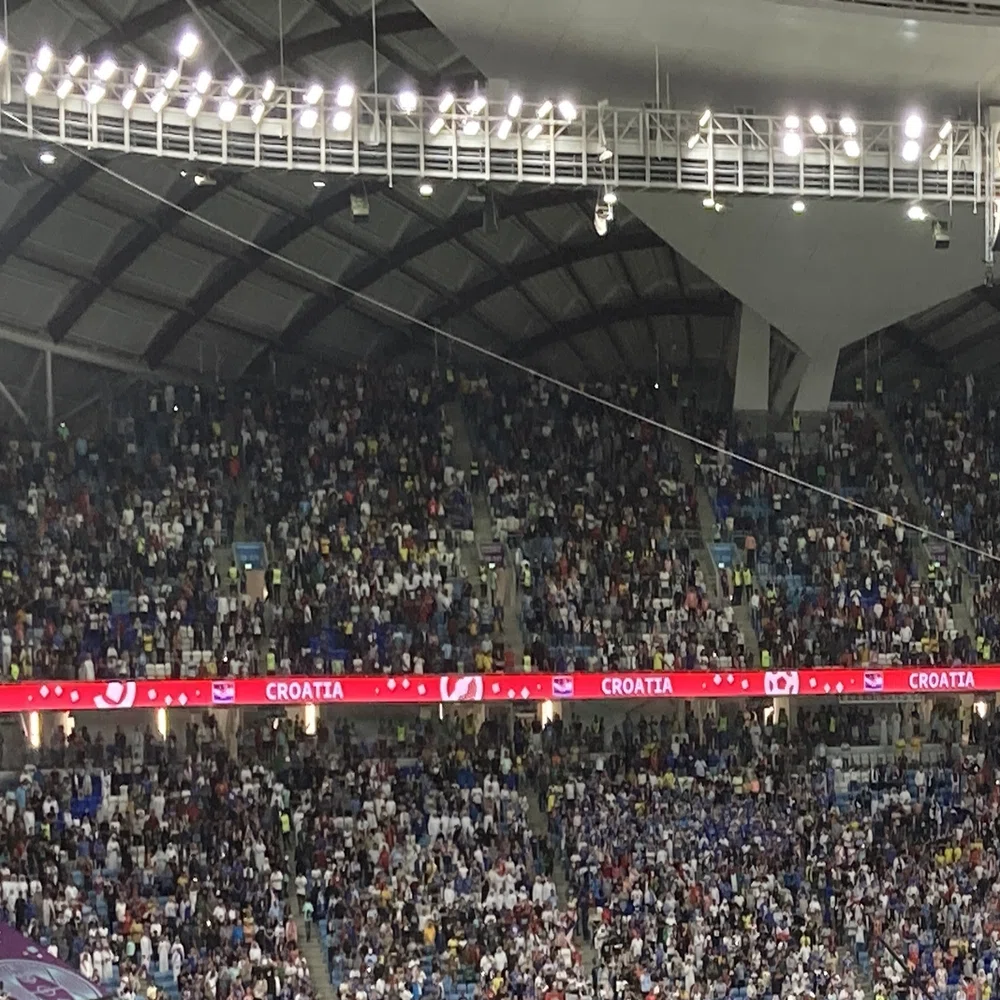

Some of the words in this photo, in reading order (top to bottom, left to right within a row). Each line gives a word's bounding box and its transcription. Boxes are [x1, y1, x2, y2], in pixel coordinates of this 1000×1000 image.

[601, 677, 672, 695] CROATIA
[909, 672, 975, 689] CROATIA
[265, 680, 344, 700] CROATIA
